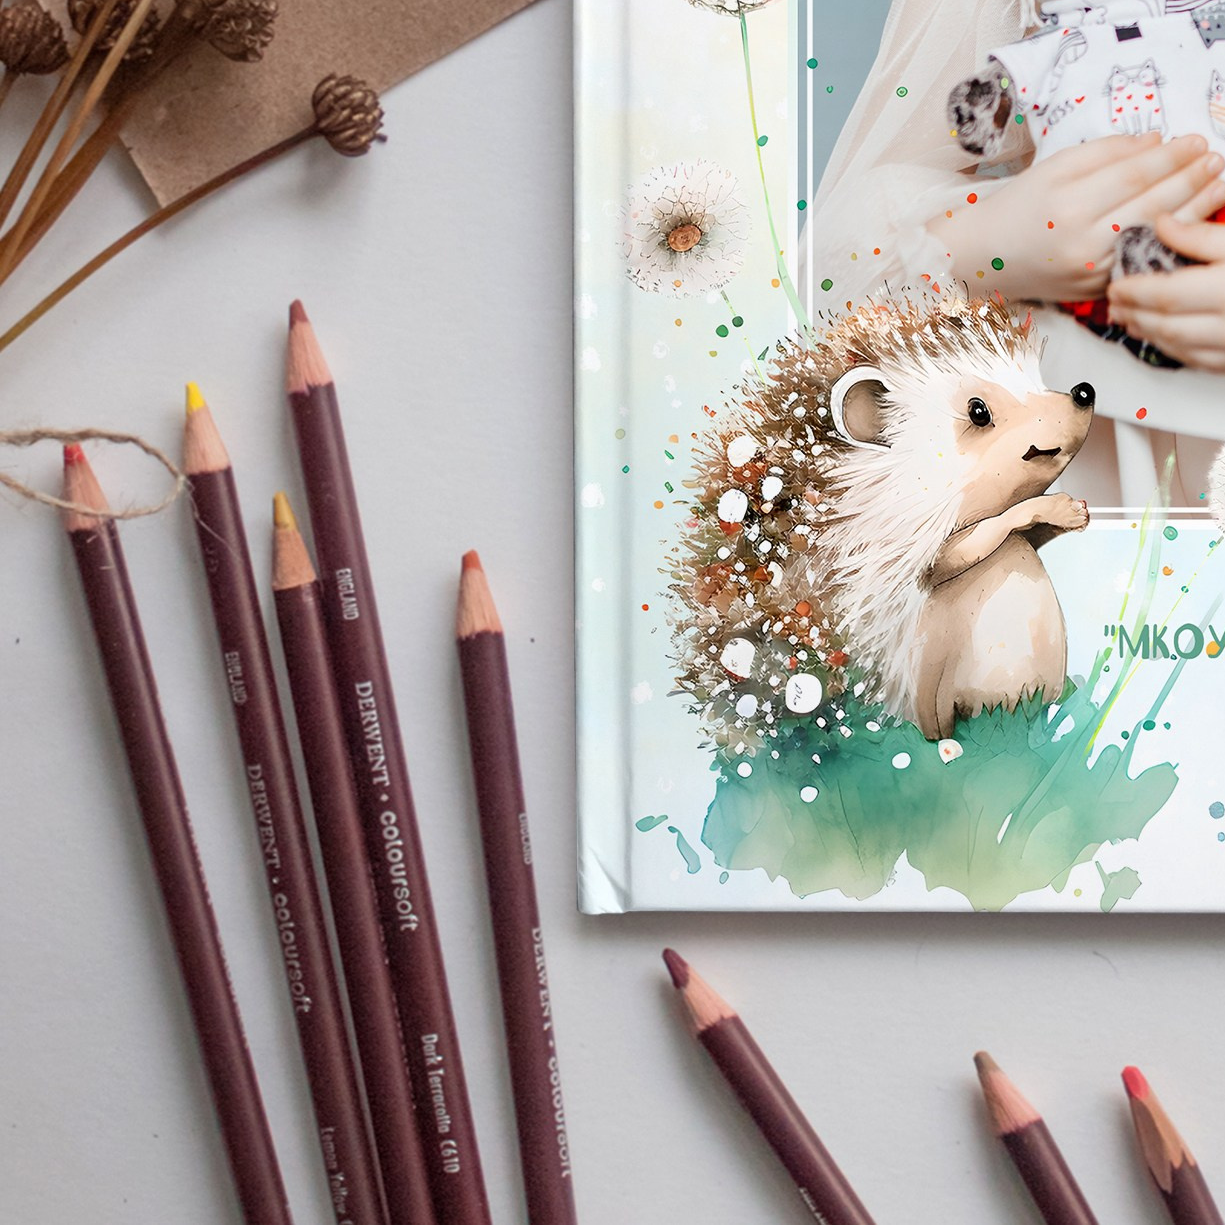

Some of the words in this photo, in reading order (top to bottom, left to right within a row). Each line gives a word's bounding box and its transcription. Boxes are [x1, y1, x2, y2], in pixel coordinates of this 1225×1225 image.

[336, 568, 359, 620] ENGLAND
[225, 651, 247, 704] ENGLAND
[355, 680, 390, 787] DERWENT
[380, 811, 419, 932] coloursoft
[248, 763, 281, 869] DERWENT
[274, 892, 312, 1013] coloursoft
[421, 1033, 444, 1066] Dark
[428, 1068, 451, 1133] Terracotta
[440, 1139, 460, 1174] C610
